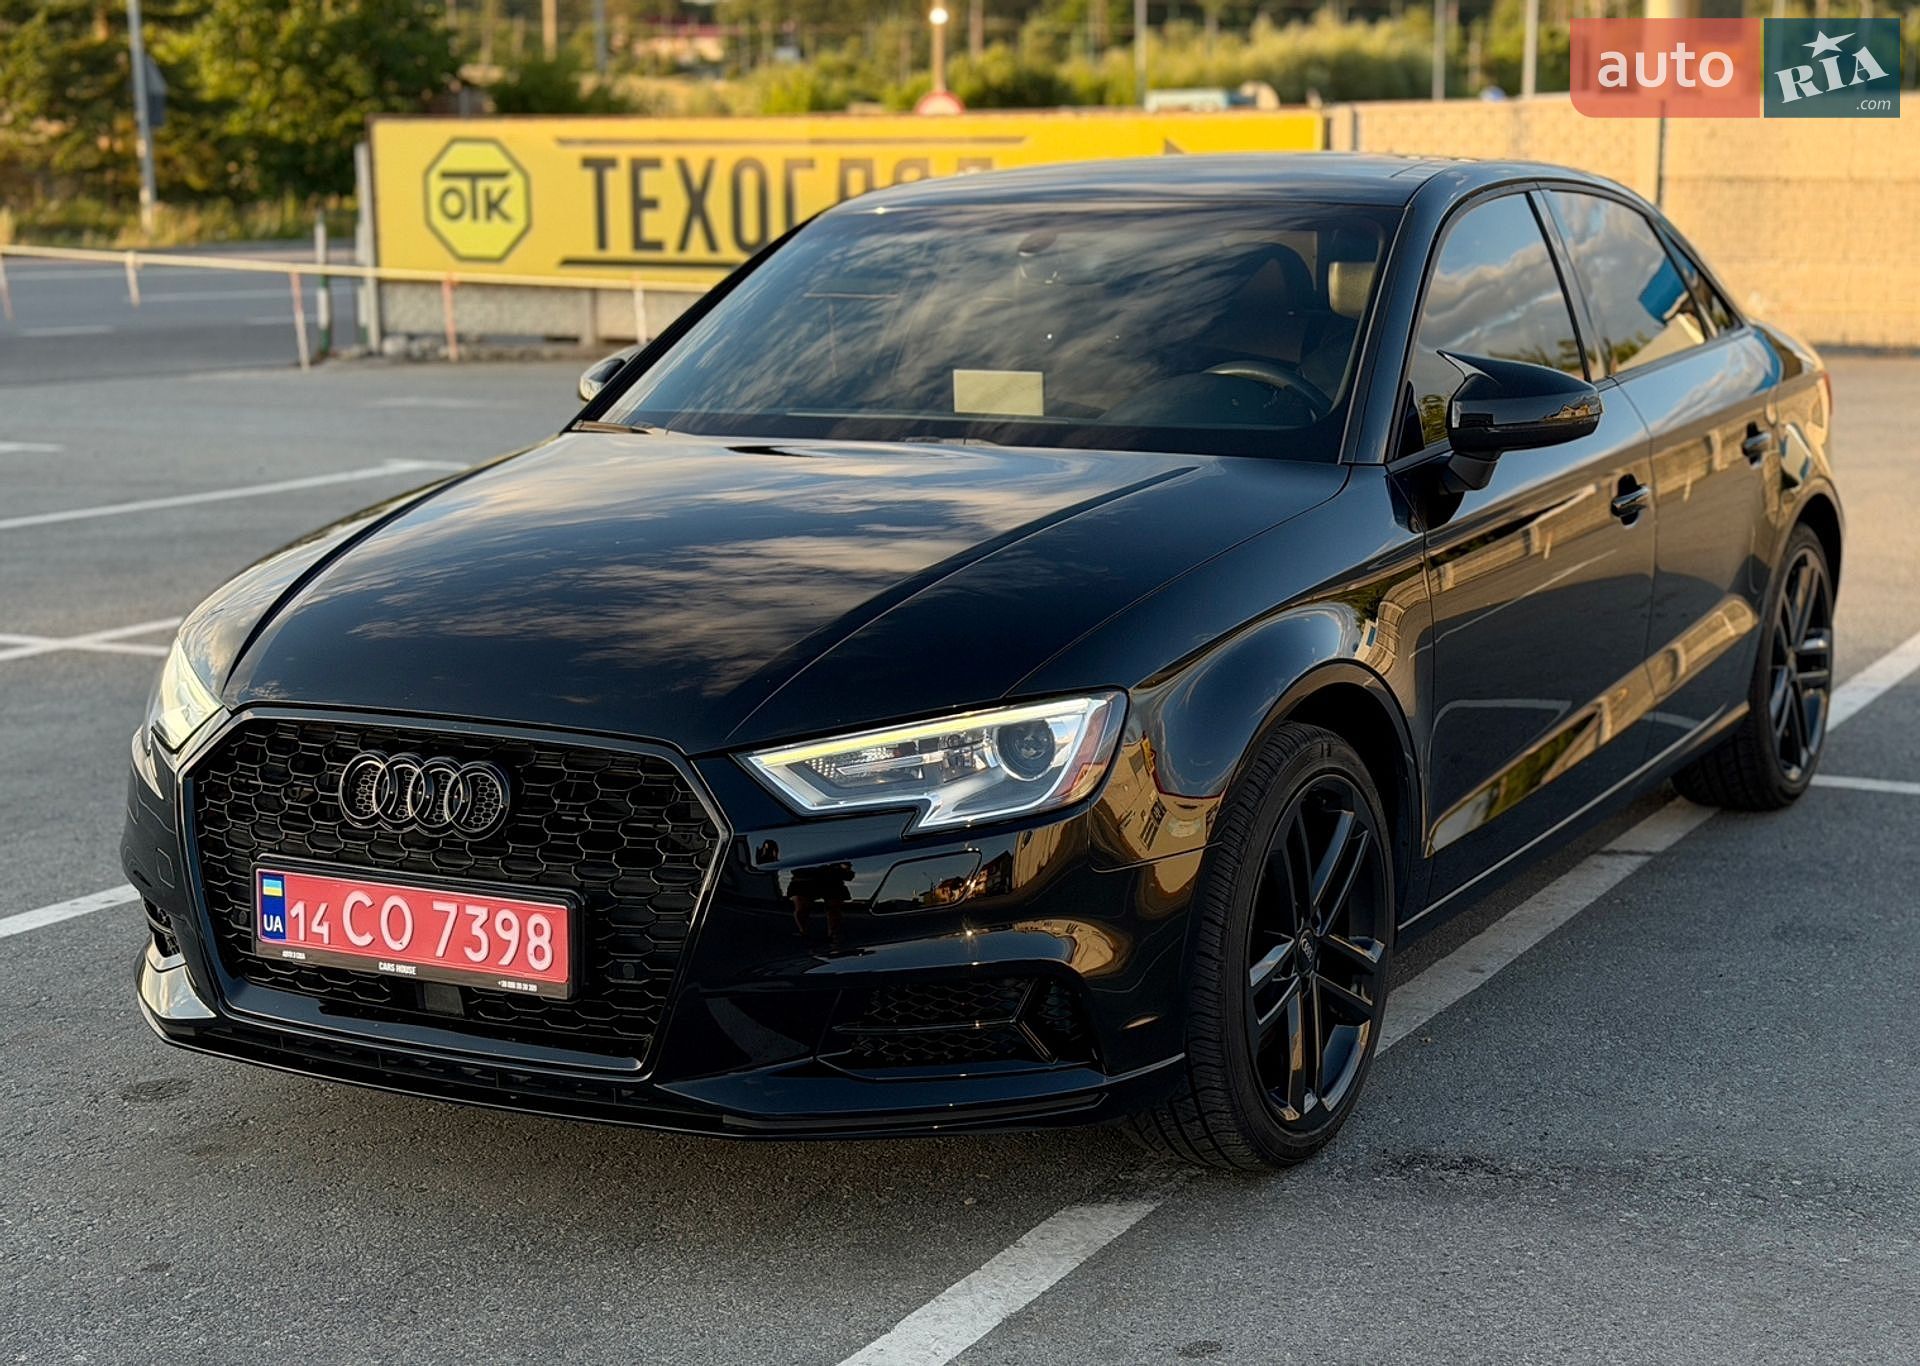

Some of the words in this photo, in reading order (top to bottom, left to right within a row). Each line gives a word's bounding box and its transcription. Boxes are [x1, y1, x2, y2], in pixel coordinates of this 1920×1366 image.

[580, 156, 994, 253] ТЕХОГ
[263, 914, 284, 934] UA
[289, 900, 332, 945] 14
[342, 890, 415, 951] CO
[431, 900, 553, 972] 7398
